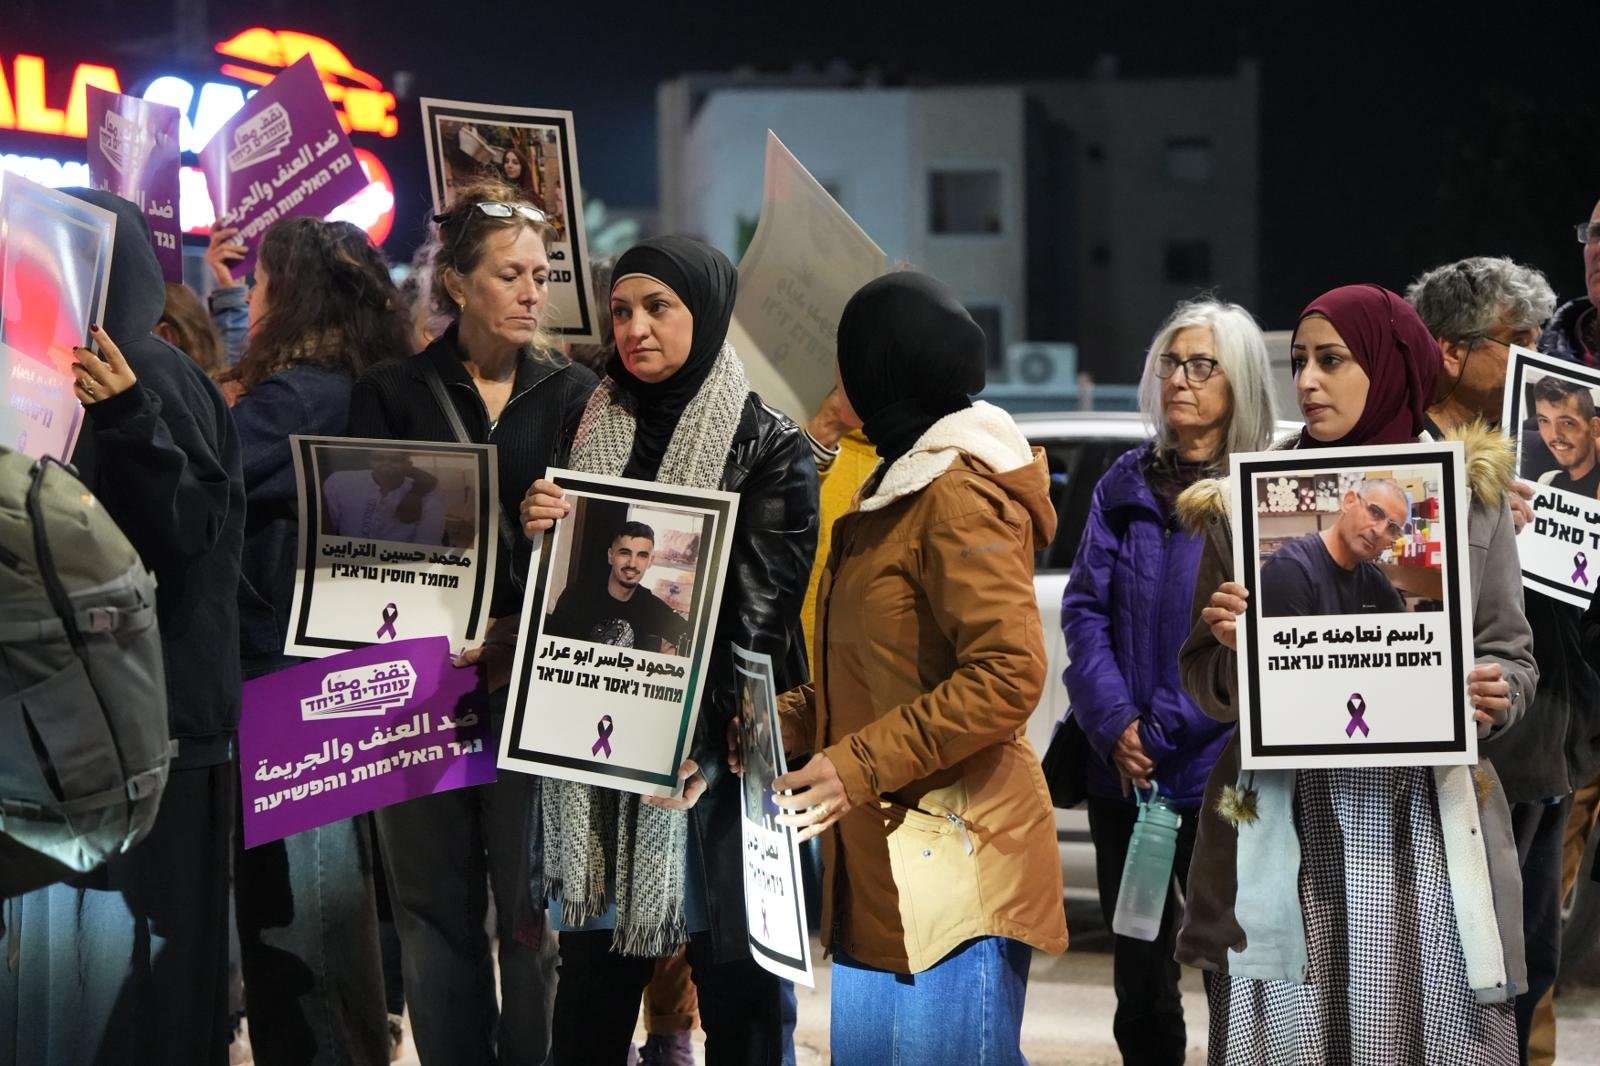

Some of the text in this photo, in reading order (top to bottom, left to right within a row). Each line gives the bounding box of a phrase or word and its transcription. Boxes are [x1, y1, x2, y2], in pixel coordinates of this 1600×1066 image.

[316, 129, 340, 157] ضد
[272, 144, 315, 188] العنف
[149, 200, 174, 219] ضد
[226, 154, 352, 246] נגד האלימות והפשיע
[153, 230, 176, 250] נגד
[1533, 492, 1580, 518] سالم
[1534, 516, 1584, 545] סאלם
[380, 550, 426, 563] حسين
[429, 552, 472, 568] محمد
[331, 563, 459, 589] מחמד חוסין טראבין
[1273, 623, 1434, 649] راسم نعامنه عرابه
[539, 641, 685, 679] محمود جاسر ابو عرار
[1268, 651, 1442, 671] ראסם נעאמנה עראבה
[367, 664, 410, 684] نقف
[537, 665, 684, 704] מחמוד ג'אסר אבו עראר
[305, 679, 410, 712] עומדים ביחד
[254, 708, 479, 782] ضد العنف والجريمة
[254, 738, 483, 814] נגד האלימות והפשיעה
